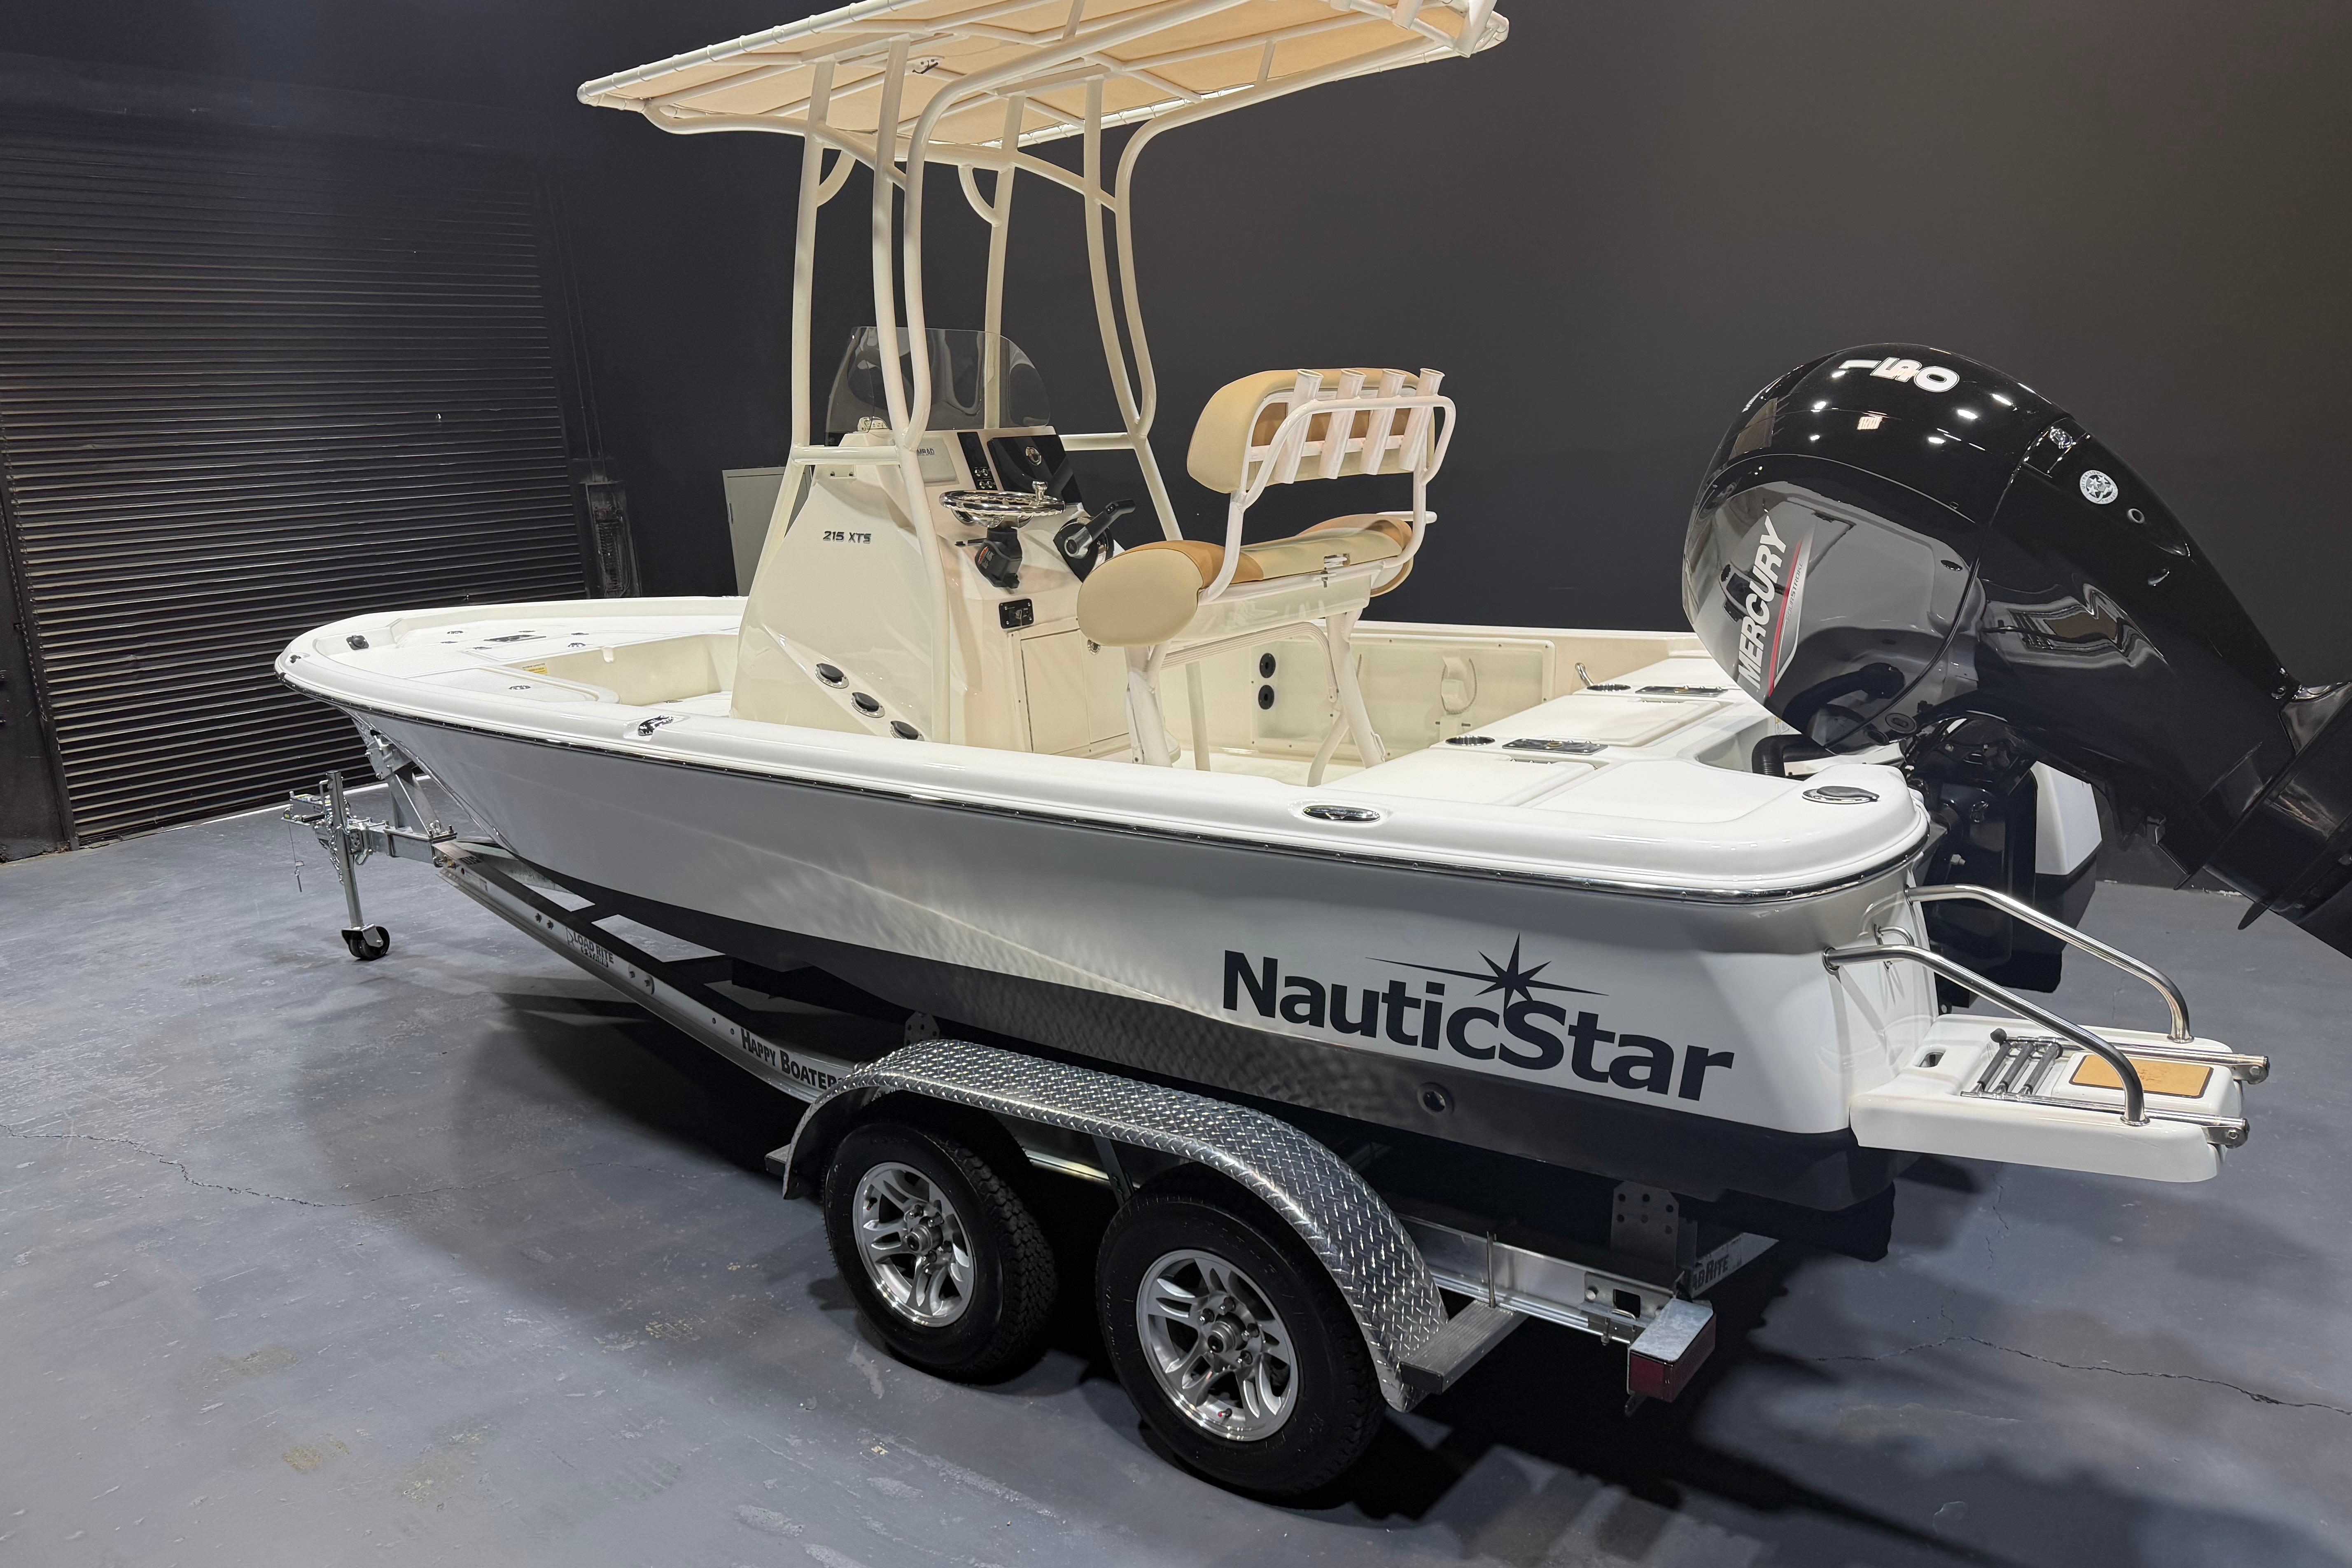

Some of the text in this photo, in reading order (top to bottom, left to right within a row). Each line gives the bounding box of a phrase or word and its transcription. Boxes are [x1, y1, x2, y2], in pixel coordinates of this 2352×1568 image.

[1839, 357, 1962, 392] 150
[917, 448, 935, 456] MRAD
[823, 530, 872, 544] 215 XTS
[1738, 516, 1786, 689] MERCURY
[1785, 559, 1804, 623] FOURSTROKE
[573, 931, 595, 952] LOAD
[595, 943, 614, 964] RITE
[1223, 950, 1735, 1101] NauticStar
[779, 1050, 844, 1090] BOATER
